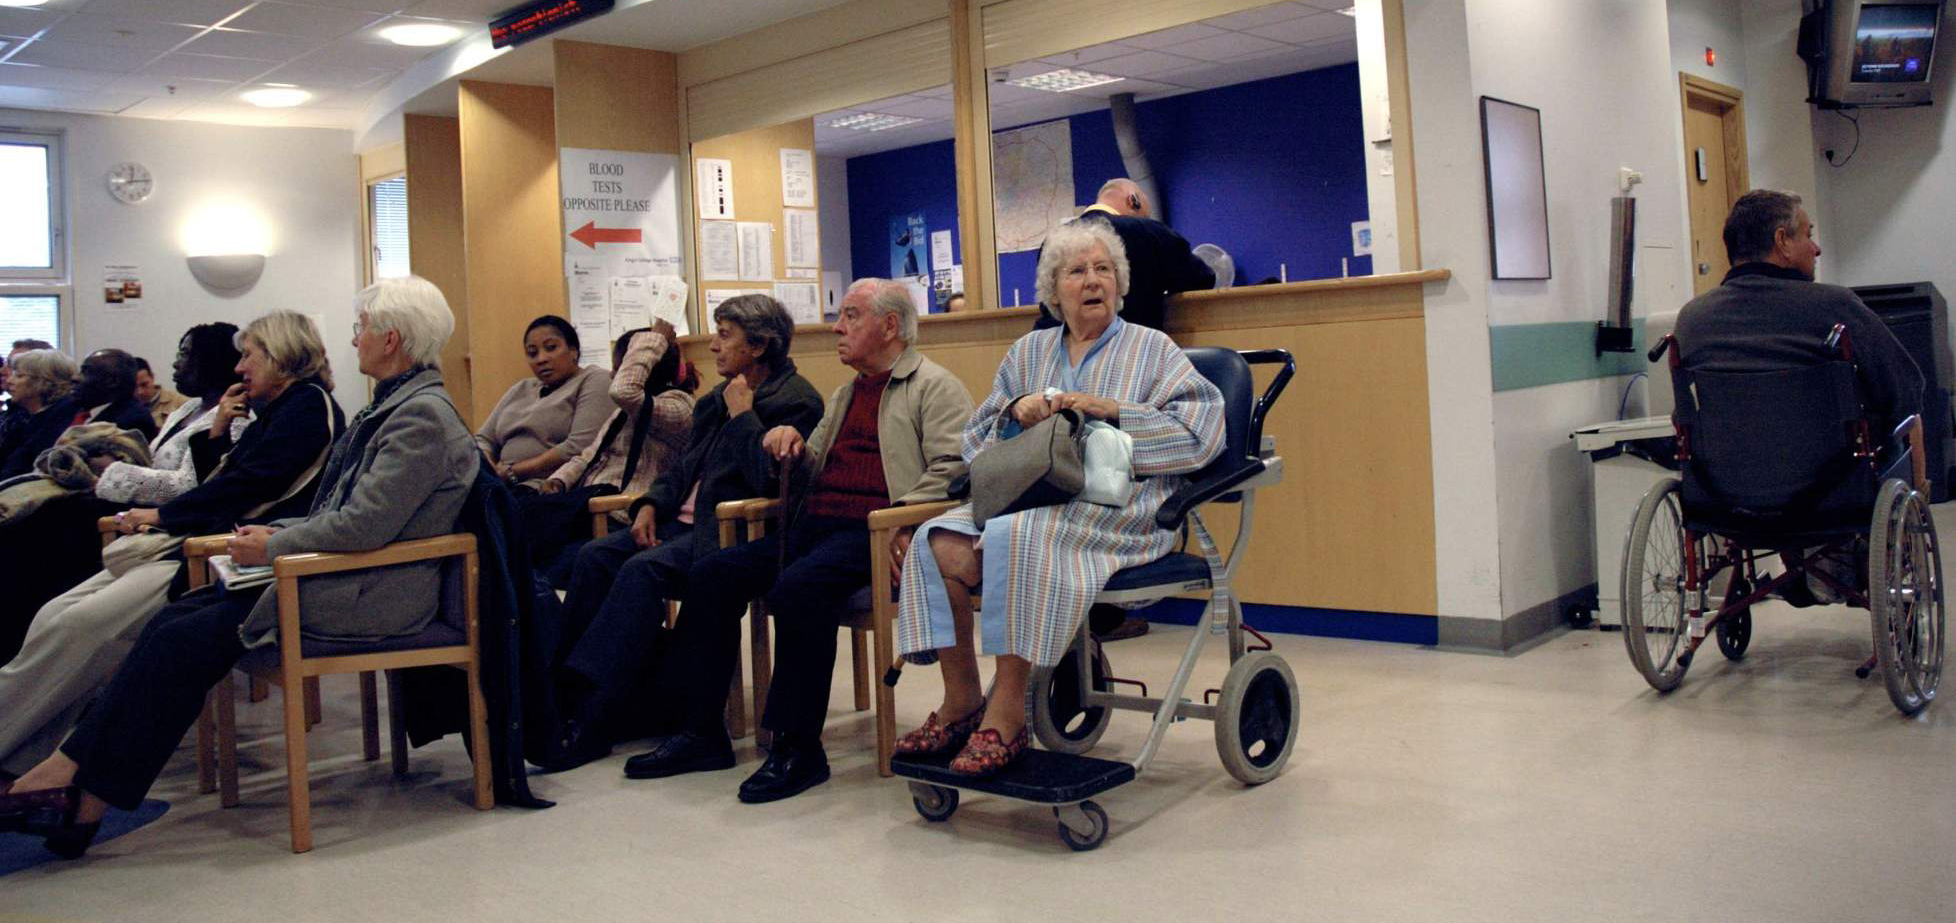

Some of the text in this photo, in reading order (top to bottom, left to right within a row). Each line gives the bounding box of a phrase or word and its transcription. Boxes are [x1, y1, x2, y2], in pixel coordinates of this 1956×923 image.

[589, 162, 624, 177] BLOOD
[592, 181, 623, 194] TESTS
[563, 197, 650, 213] OPPOSITE PLEASE
